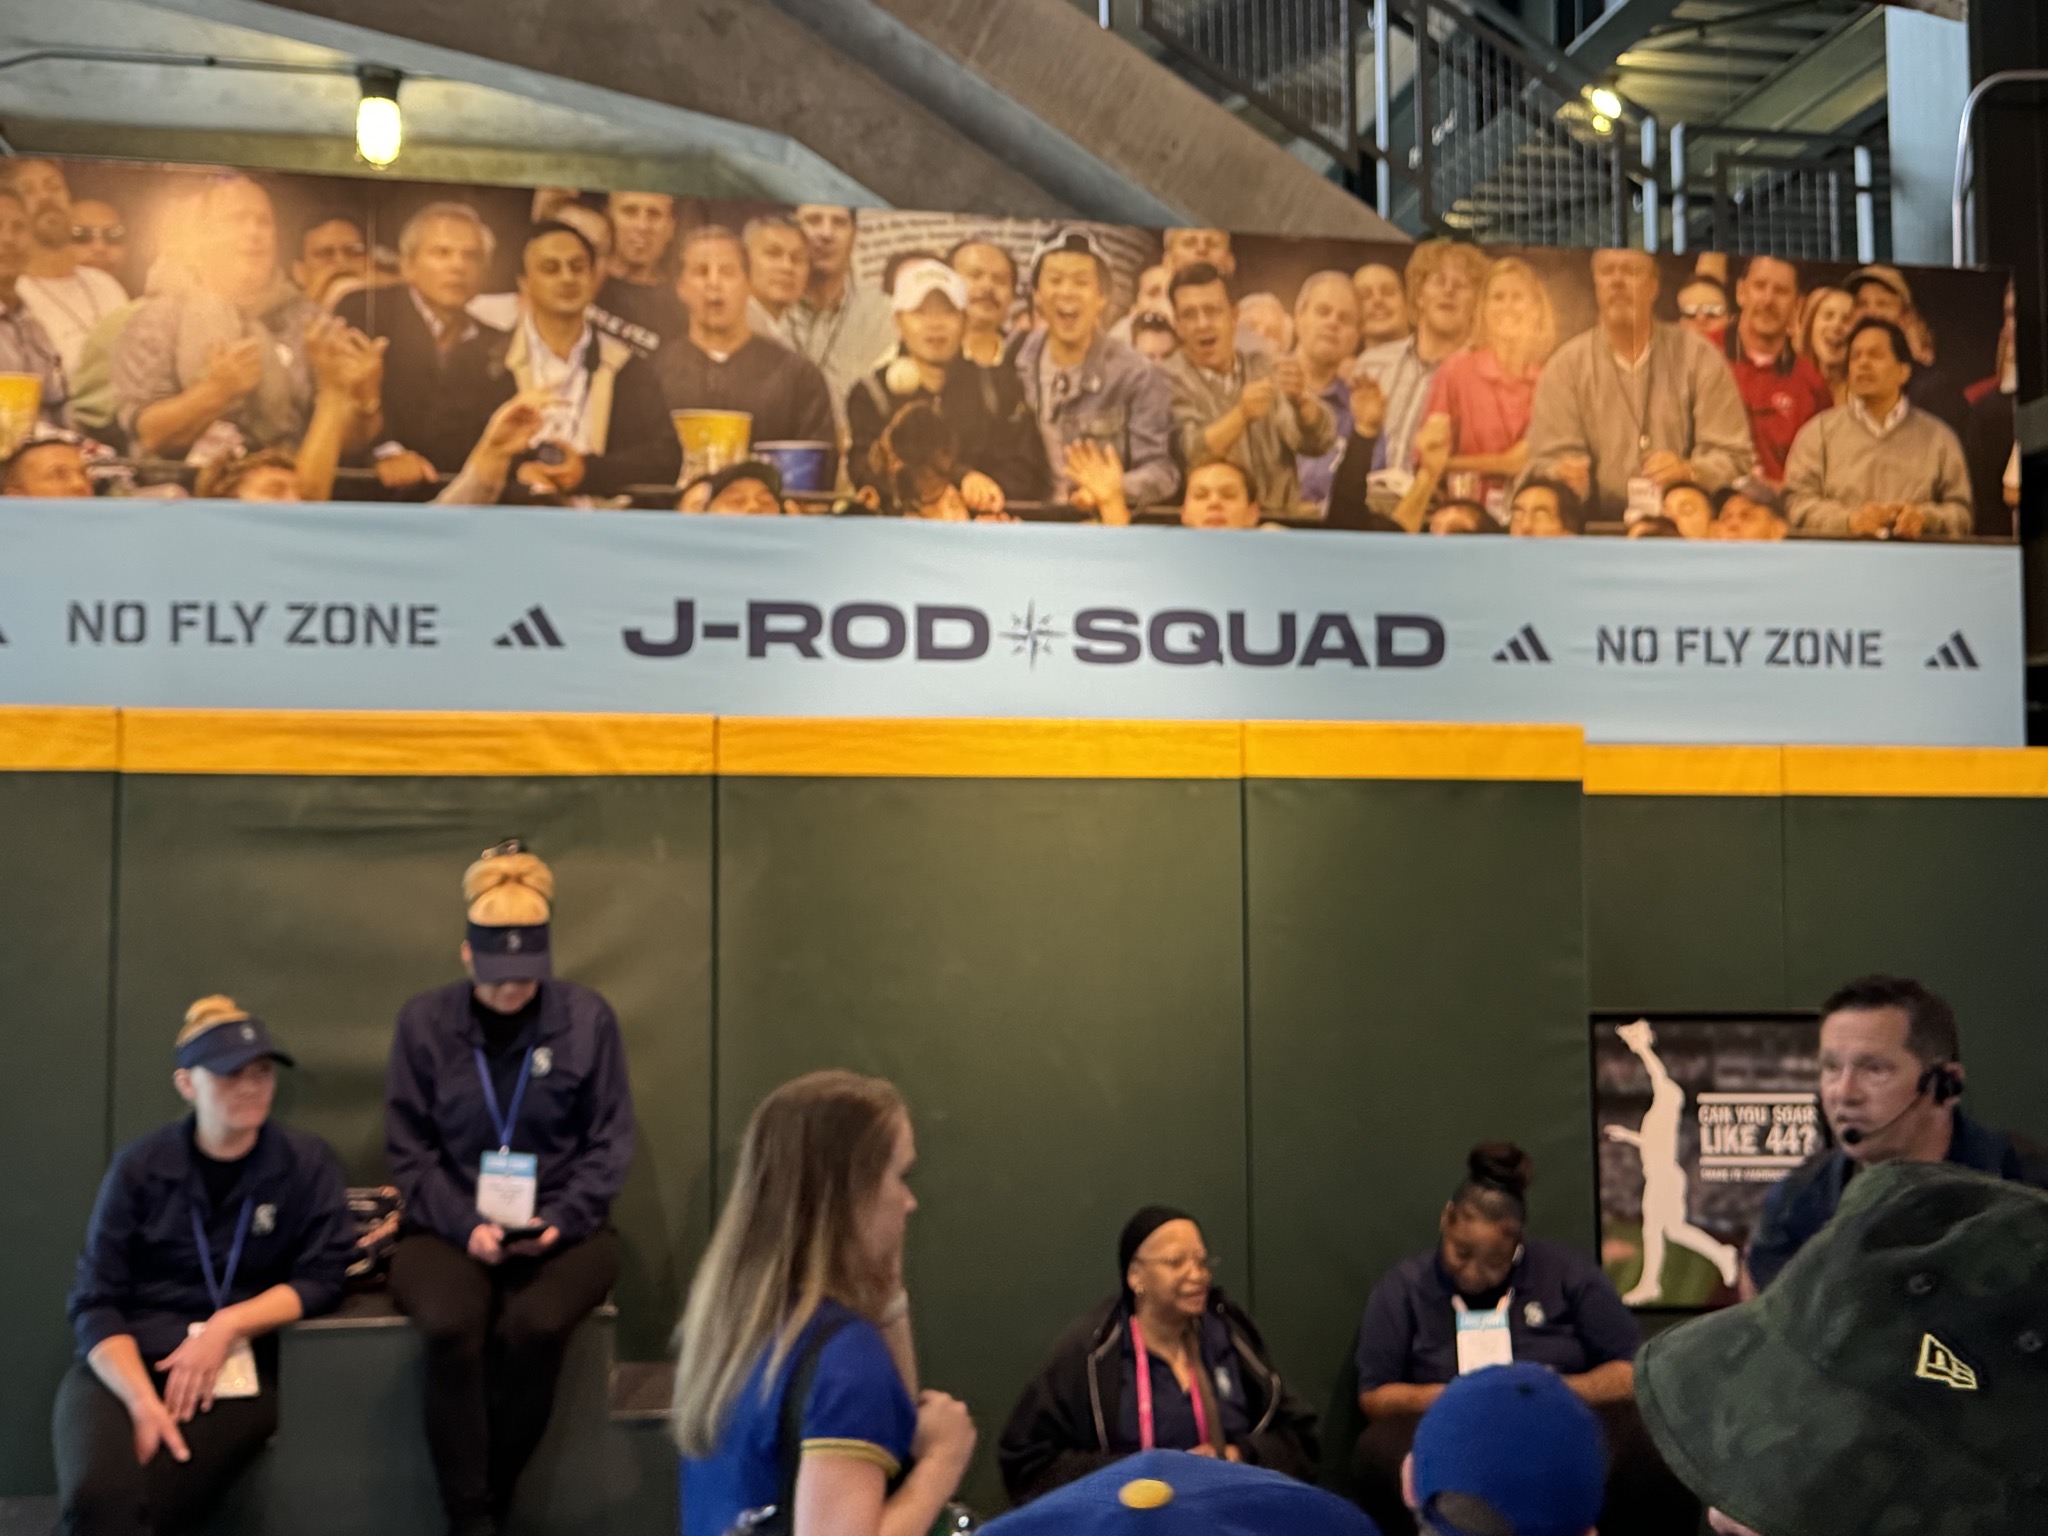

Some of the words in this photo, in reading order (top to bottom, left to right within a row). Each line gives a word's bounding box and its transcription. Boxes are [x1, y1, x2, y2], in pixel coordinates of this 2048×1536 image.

[67, 600, 147, 645] NO
[169, 601, 267, 646] FLY
[285, 602, 439, 648] ZONE
[621, 598, 990, 660] J-ROD
[1073, 608, 1447, 670] SQUAD
[1597, 625, 1659, 665] NO
[1675, 627, 1752, 667] FLY
[1764, 628, 1883, 669] ZONE
[1698, 1105, 1733, 1125] CAN
[1735, 1105, 1769, 1125] YOU
[1700, 1124, 1759, 1155] LIKE
